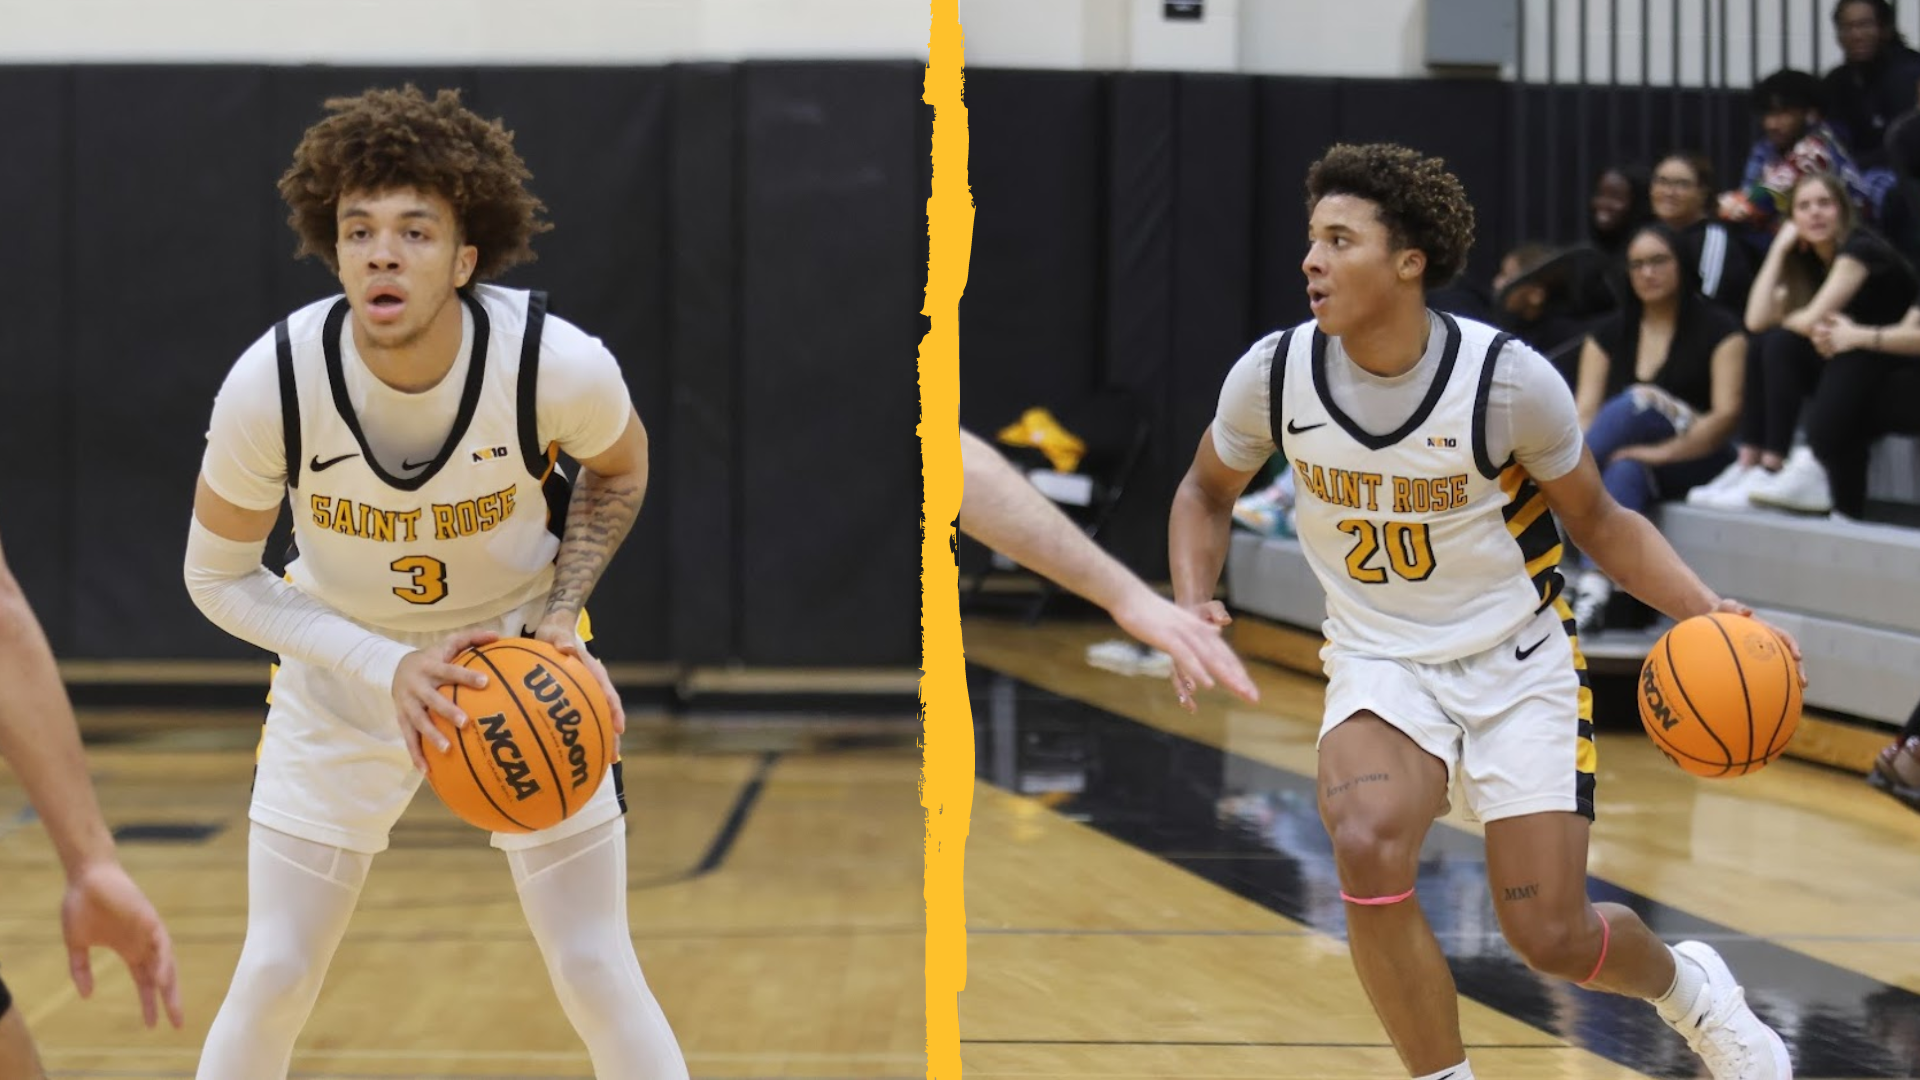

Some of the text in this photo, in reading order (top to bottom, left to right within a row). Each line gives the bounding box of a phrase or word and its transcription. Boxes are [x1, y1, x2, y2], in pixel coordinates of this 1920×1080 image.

[310, 493, 423, 542] SAINT
[431, 483, 517, 541] ROSE
[1294, 458, 1468, 513] SAINT ROSE
[390, 555, 449, 605] 3
[1336, 519, 1437, 584] 20
[523, 663, 589, 791] Wilson
[1643, 660, 1679, 732] NCAA
[477, 713, 541, 802] NCAA
